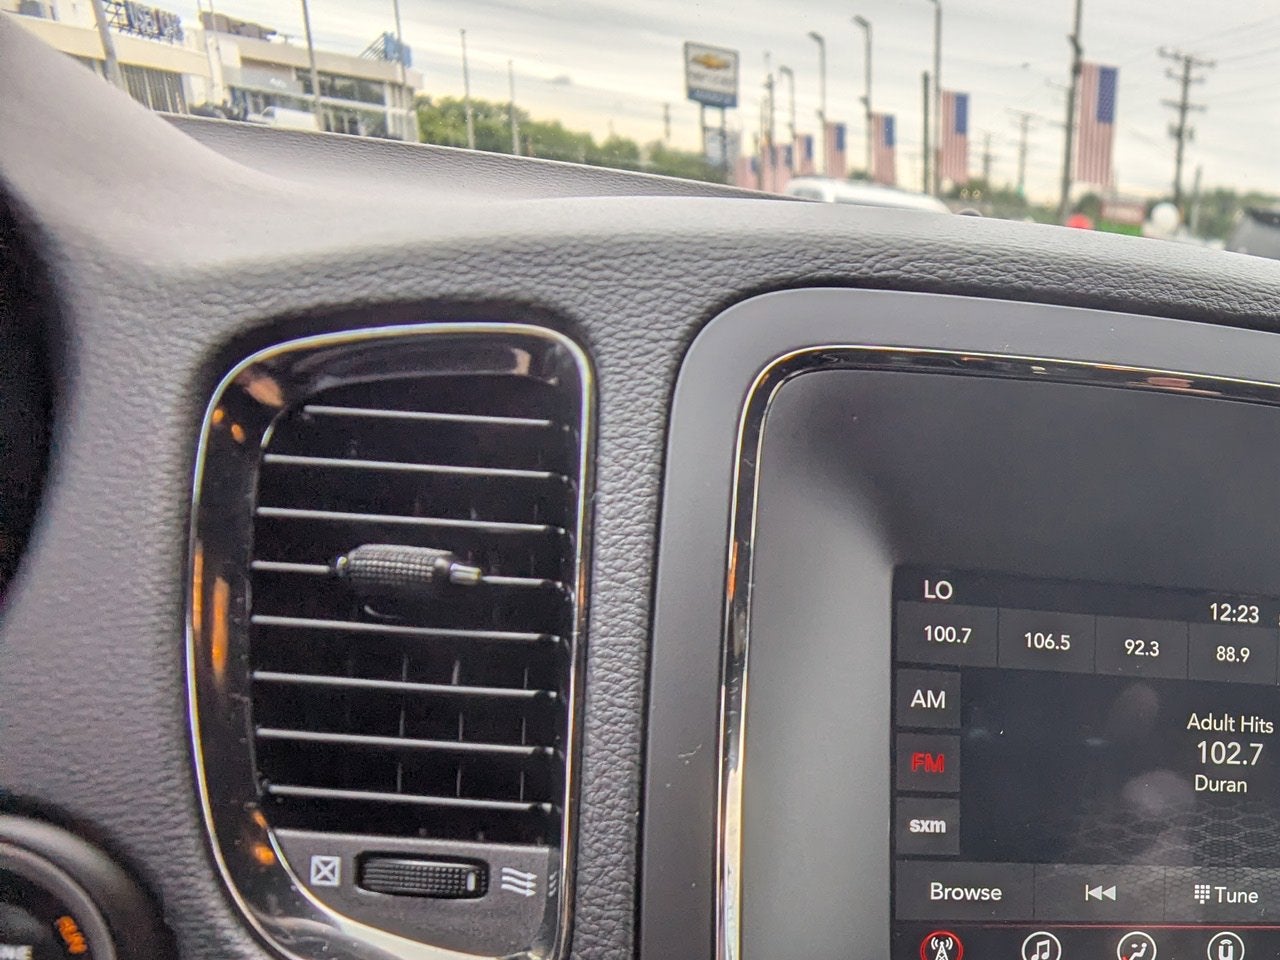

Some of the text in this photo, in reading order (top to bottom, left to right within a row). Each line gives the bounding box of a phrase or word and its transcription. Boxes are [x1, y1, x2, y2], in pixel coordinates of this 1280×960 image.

[924, 579, 953, 600] LO
[1210, 602, 1260, 624] 12:23
[924, 625, 972, 644] 100.7
[1024, 632, 1071, 651] 106.5
[1124, 638, 1160, 657] 92.3
[1216, 645, 1250, 663] 88.9
[910, 689, 946, 709] AM
[1186, 712, 1274, 734] Adult Hits
[911, 752, 945, 773] FM
[1197, 740, 1264, 766] 102.7
[1195, 774, 1248, 793] Duran
[909, 819, 946, 833] sxm
[930, 882, 1003, 901] Browse
[1214, 886, 1259, 904] Tune
